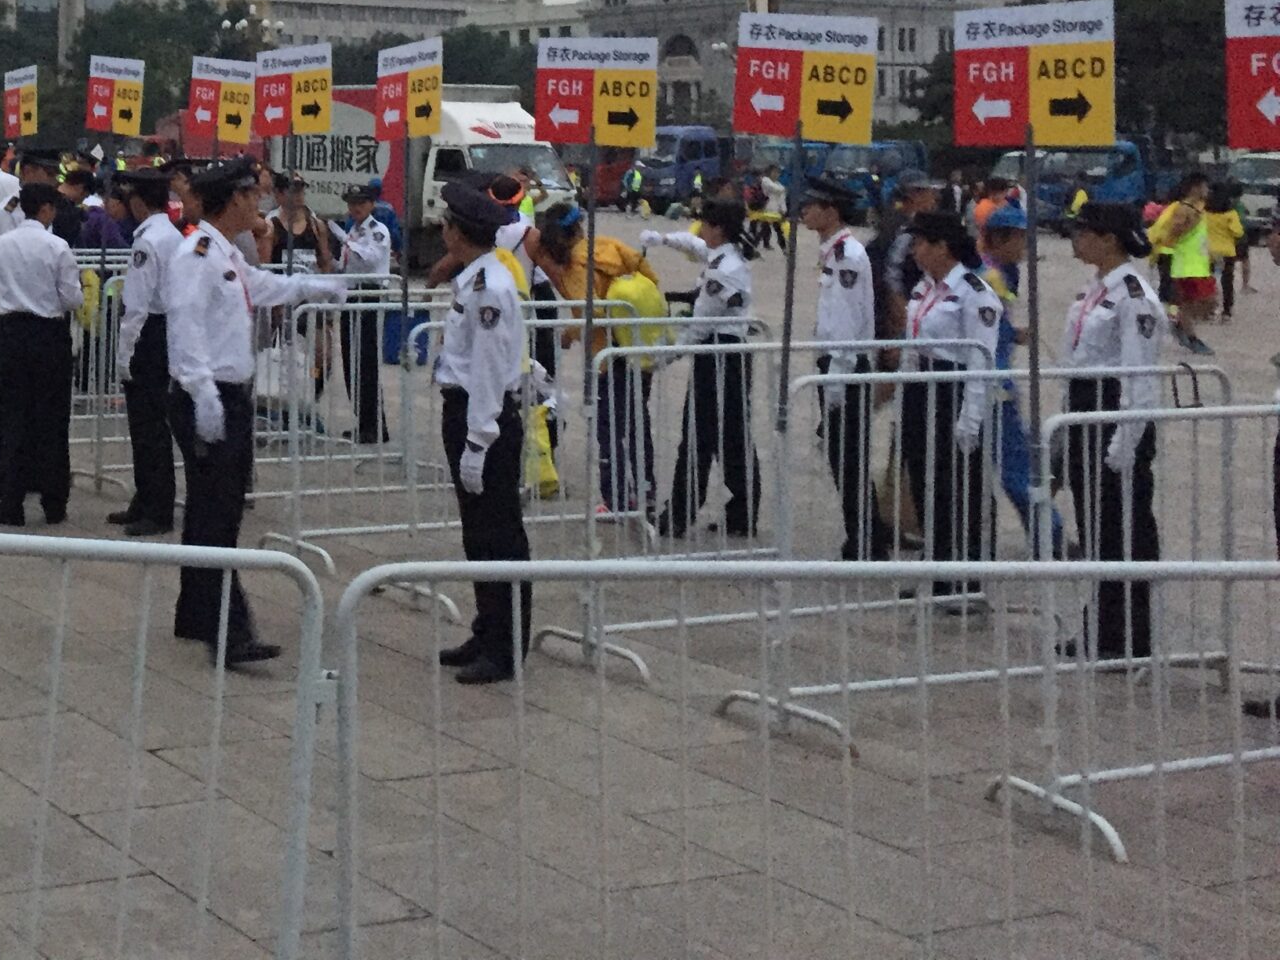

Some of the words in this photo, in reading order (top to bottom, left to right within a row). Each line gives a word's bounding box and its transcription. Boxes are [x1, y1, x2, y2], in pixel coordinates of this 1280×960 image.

[750, 23, 777, 40] 存衣
[778, 28, 822, 44] Package
[825, 30, 868, 47] Storage
[965, 21, 997, 40] 存衣
[998, 22, 1050, 38] Package
[1052, 18, 1104, 35] Storage
[547, 46, 571, 61] 存衣
[572, 49, 610, 63] Package
[612, 50, 650, 64] Storage
[749, 59, 790, 80] FGH
[809, 64, 867, 85] ABCD
[968, 61, 1015, 83] FGH
[1037, 56, 1105, 80] ABCD
[196, 86, 215, 100] FGH
[263, 83, 286, 97] FGH
[296, 78, 328, 93] ABCD
[382, 82, 402, 100] FGH
[410, 76, 438, 94] ABCD
[547, 79, 583, 96] FGH
[600, 81, 650, 97] ABCD
[223, 90, 250, 105] ABCD
